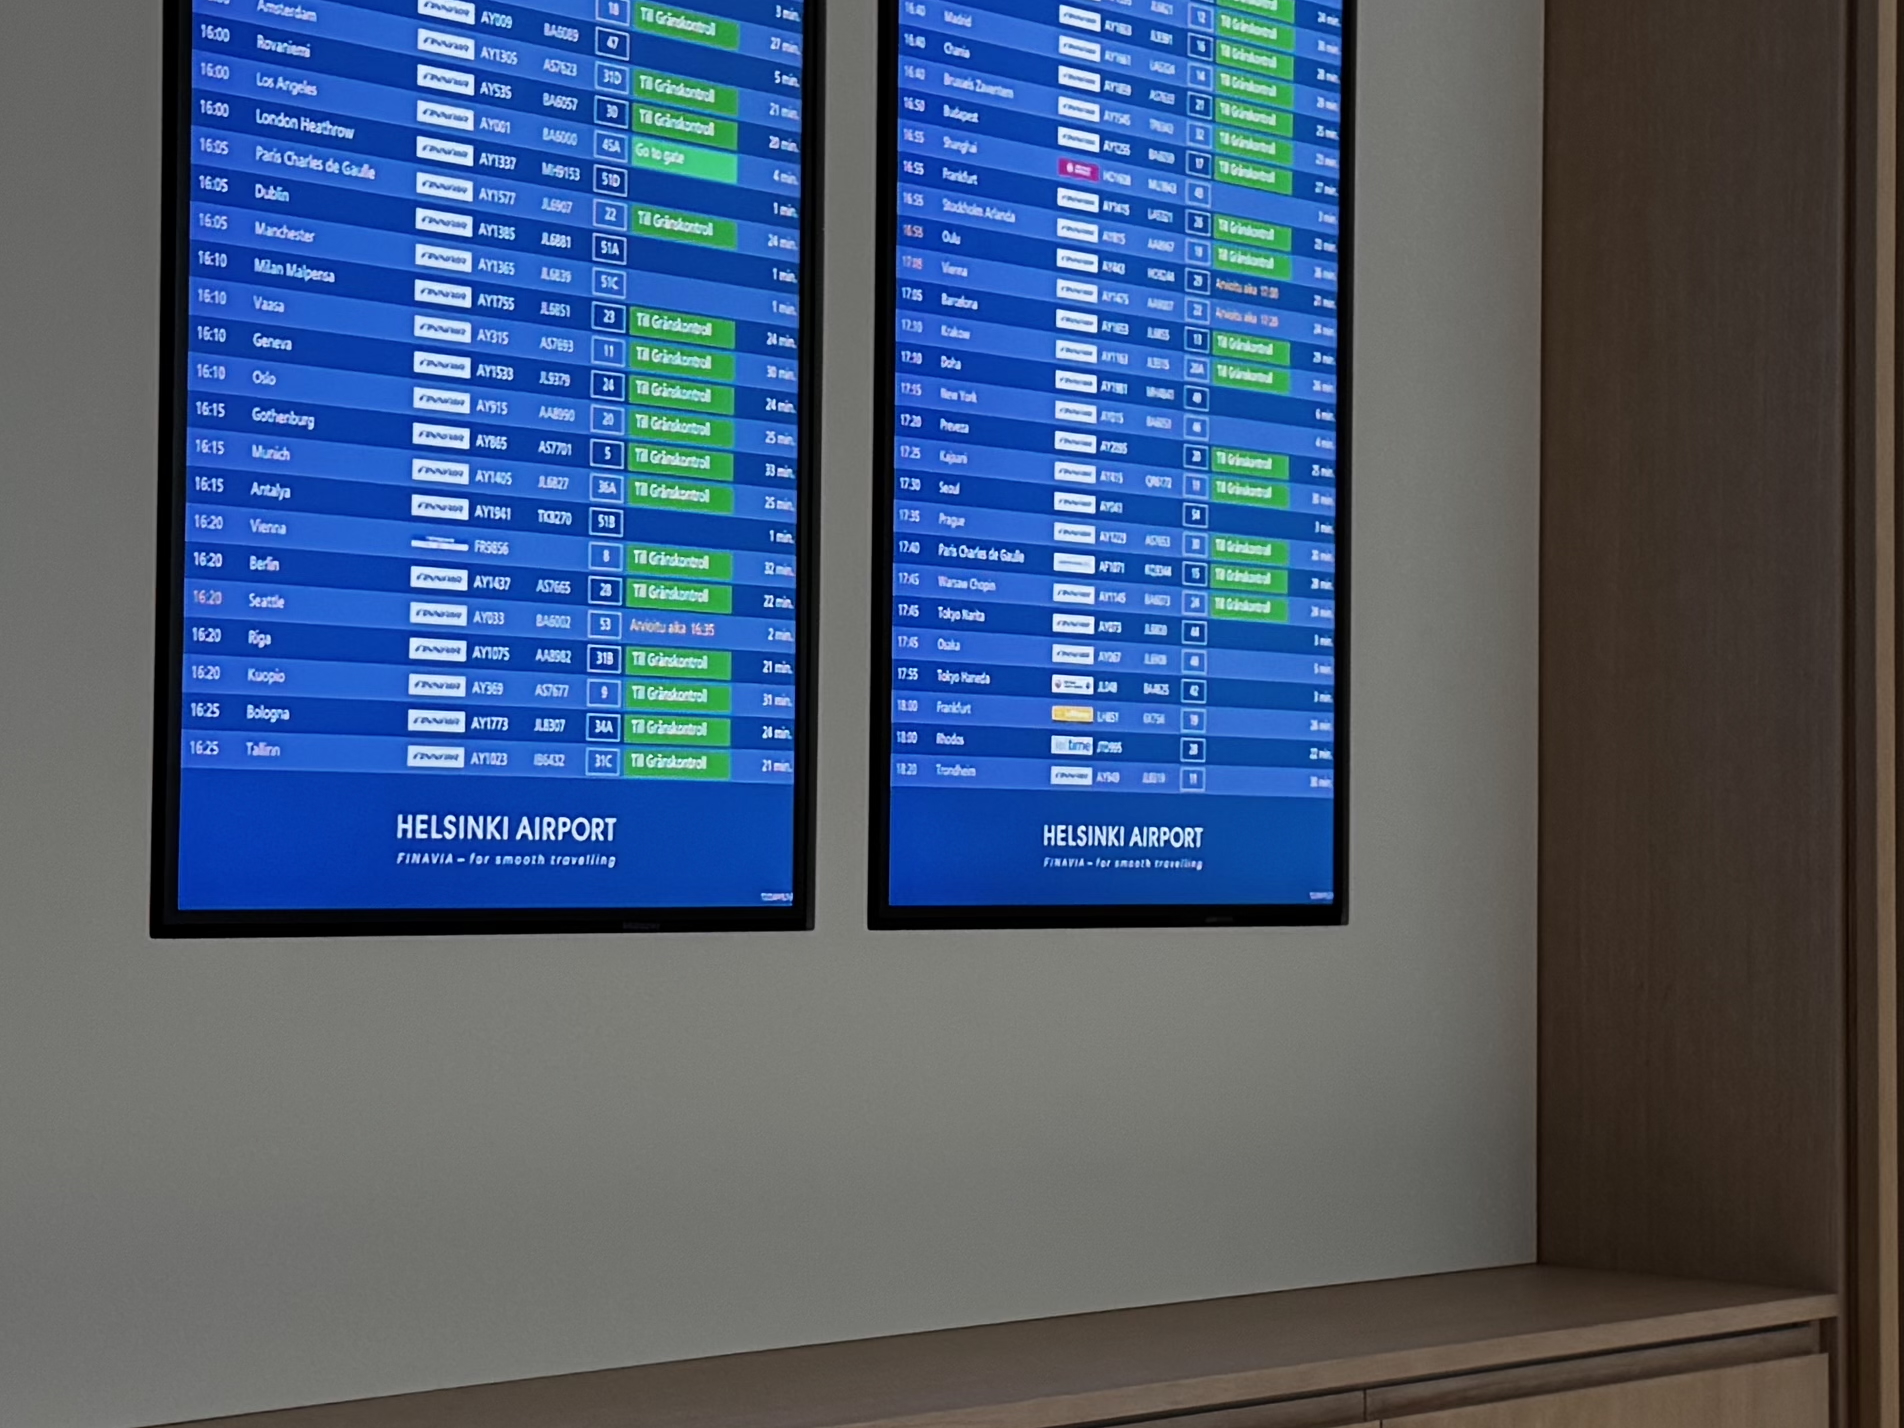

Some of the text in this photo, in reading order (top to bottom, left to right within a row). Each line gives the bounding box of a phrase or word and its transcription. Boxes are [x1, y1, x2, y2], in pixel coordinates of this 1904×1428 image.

[255, 71, 275, 89] Los
[274, 75, 318, 97] Angeles
[254, 107, 299, 130] London
[299, 115, 355, 140] Heathrow
[254, 144, 282, 164] Paris
[282, 149, 324, 171] Charles
[324, 157, 340, 174] de
[340, 159, 376, 180] Gaulle
[253, 182, 290, 203] Dublin
[253, 220, 316, 243] Manchester
[253, 256, 285, 276] Milan
[284, 261, 336, 283] Malpensa
[252, 294, 285, 314] Vaasa
[251, 331, 293, 351] Geneva
[251, 369, 277, 386] Oslo
[250, 405, 315, 431] Gothenburg
[250, 443, 291, 461] Munich
[249, 480, 291, 501] Antalya
[248, 517, 287, 535] Vienna
[248, 554, 280, 572] Berlin
[248, 591, 286, 609] Seattle
[247, 628, 272, 649] Riga
[246, 667, 286, 685] Kuopio
[245, 703, 291, 724] Bologna
[245, 740, 281, 757] Tallinn
[395, 813, 618, 842] HELSINKI AIRPORT
[1042, 823, 1204, 849] HELSINKI AIRPORT
[395, 851, 617, 869] FINAVIA for smooth travelling
